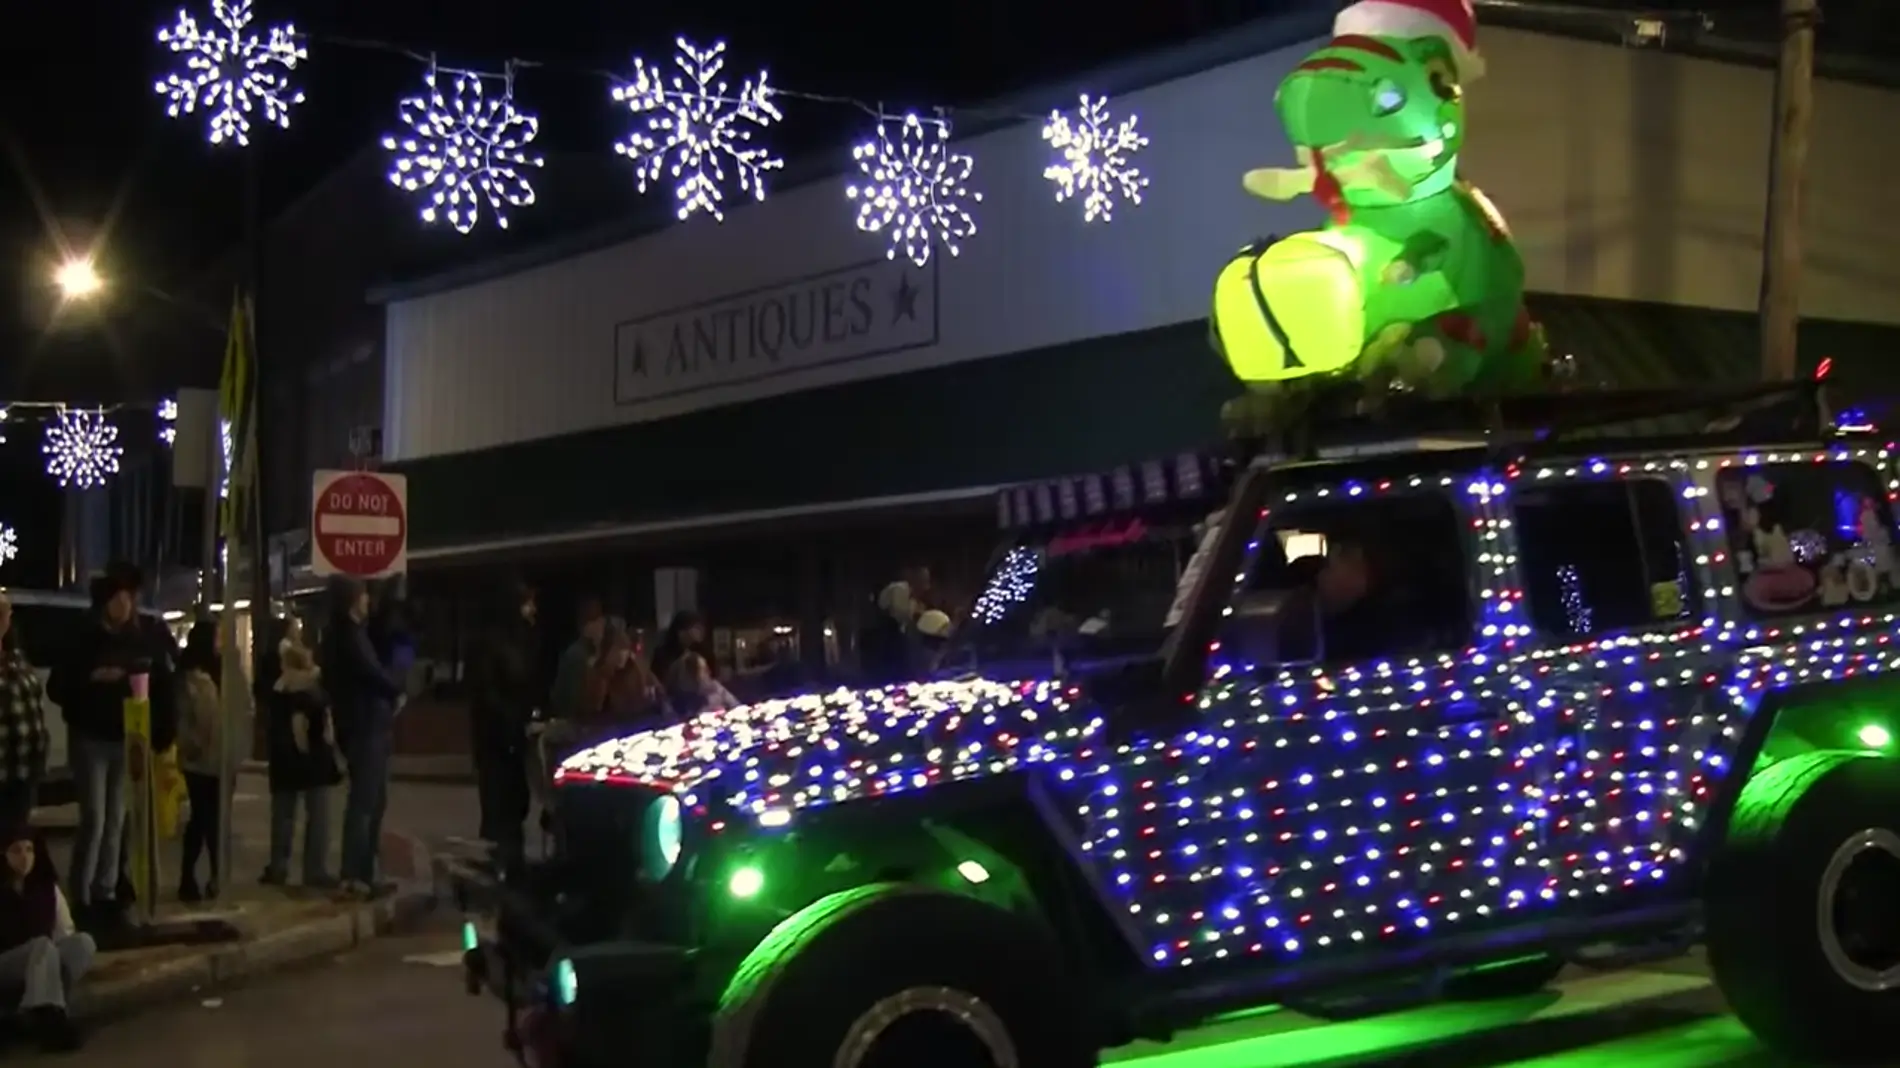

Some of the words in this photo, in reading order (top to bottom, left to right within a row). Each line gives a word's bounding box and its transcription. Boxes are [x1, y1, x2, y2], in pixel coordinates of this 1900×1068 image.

[664, 276, 872, 376] ANTIQUES
[330, 493, 352, 511] DO
[359, 494, 390, 514] NOT
[335, 538, 385, 557] ENTER
